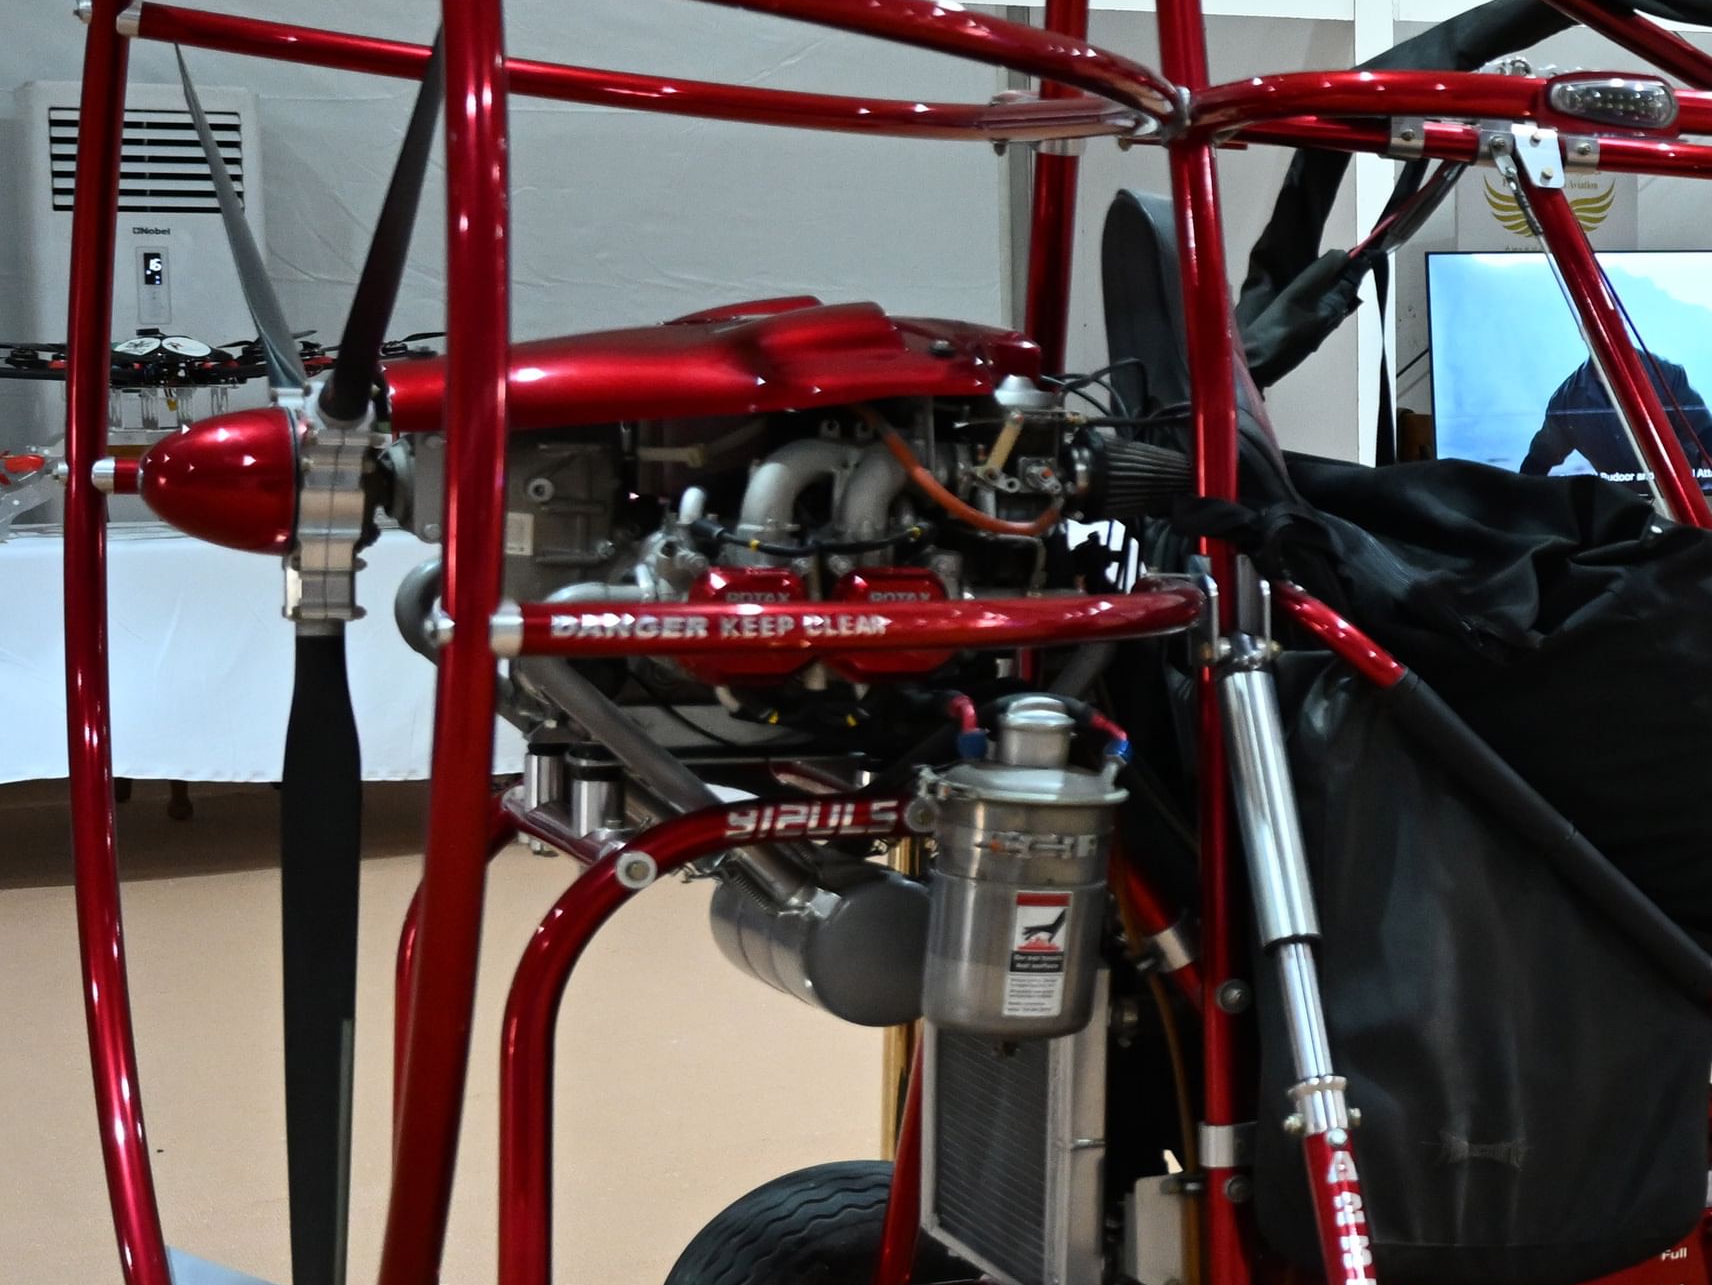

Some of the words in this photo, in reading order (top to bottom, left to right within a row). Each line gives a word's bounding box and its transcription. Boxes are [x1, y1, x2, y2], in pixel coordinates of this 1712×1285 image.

[727, 592, 790, 603] ROTAX
[869, 591, 931, 602] ROTAX
[551, 615, 708, 639] DANGER
[720, 615, 796, 639] KEEP
[802, 615, 888, 637] CLEAR
[1661, 1247, 1688, 1262] Full
